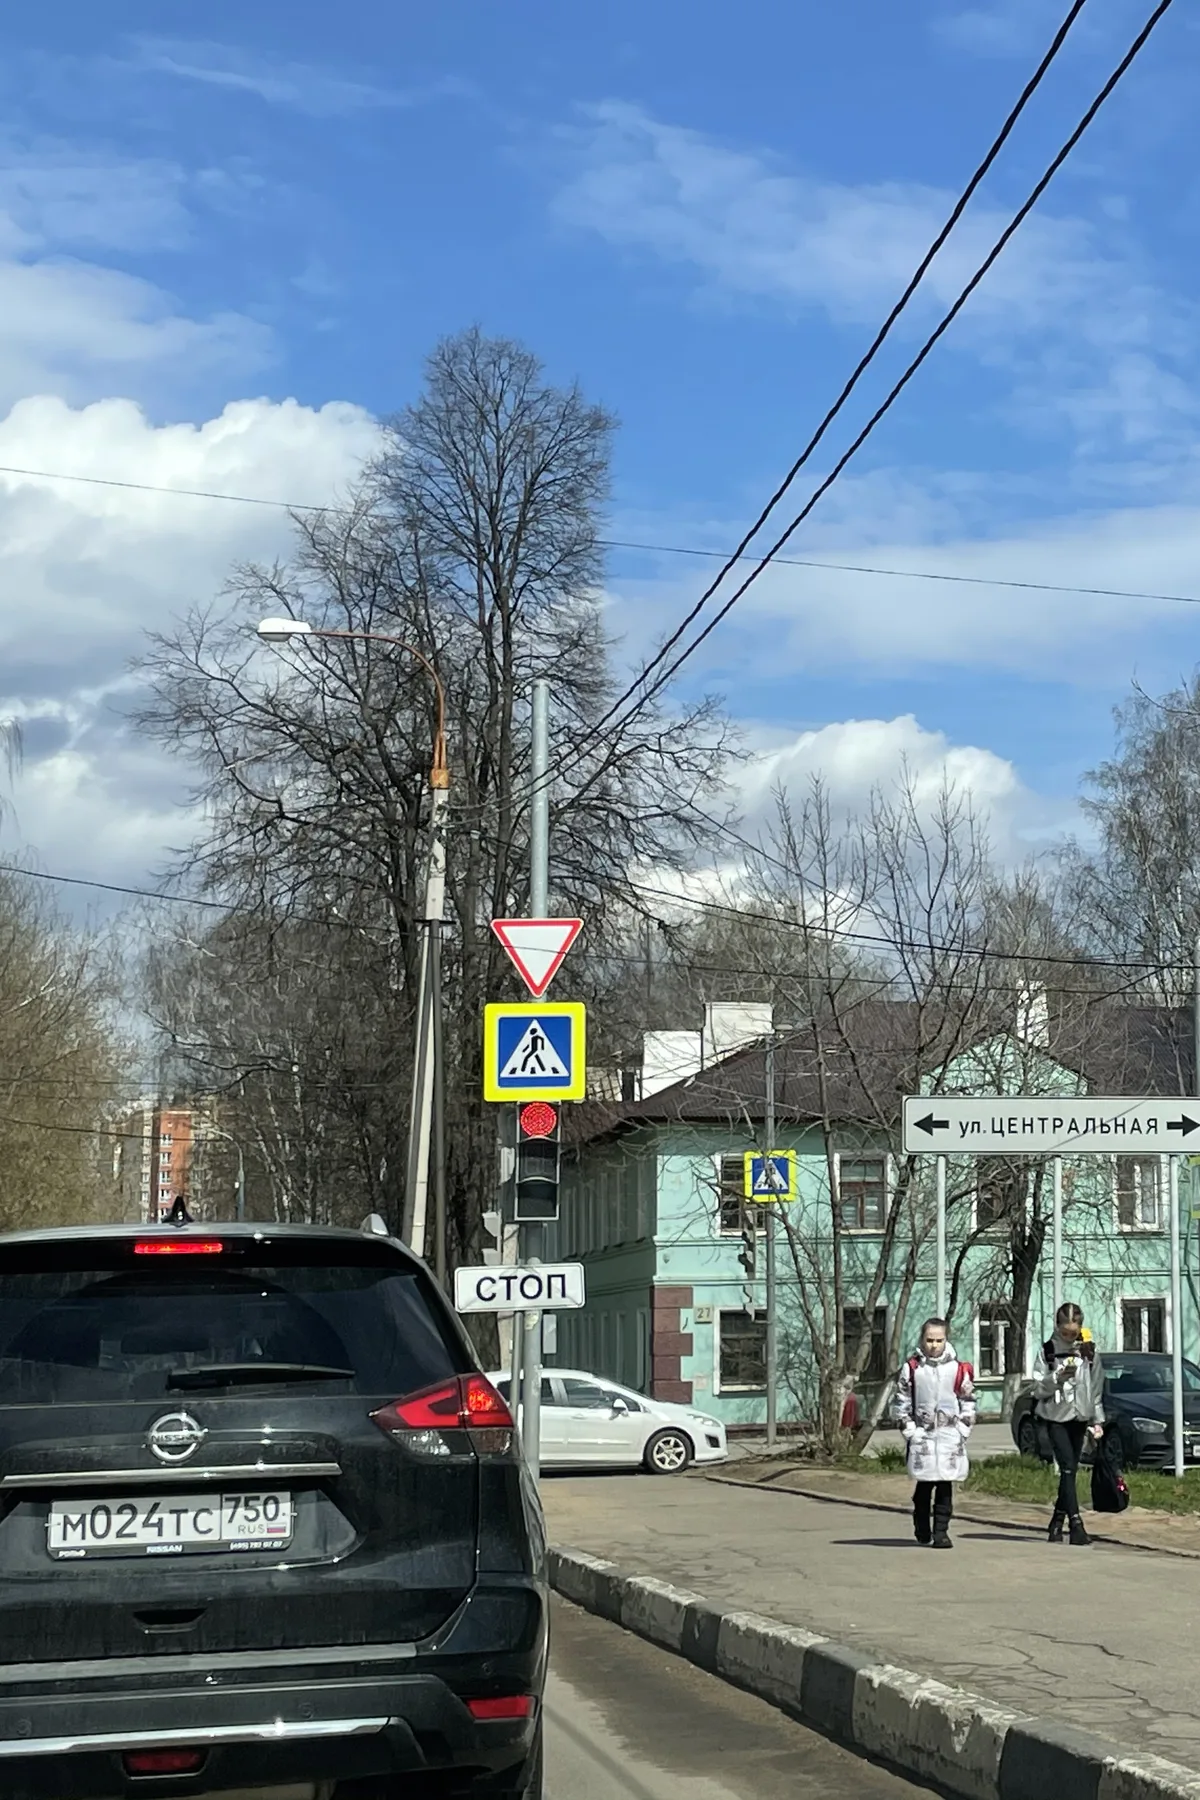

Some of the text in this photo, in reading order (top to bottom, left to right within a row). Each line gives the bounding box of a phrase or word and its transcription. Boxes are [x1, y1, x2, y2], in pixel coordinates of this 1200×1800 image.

[991, 1116, 1158, 1138] ЦЕНТРАЛЬНАЯ
[476, 1273, 567, 1302] СТОП
[697, 1307, 710, 1319] 27
[223, 1494, 280, 1524] 750
[237, 1523, 265, 1534] RUS
[146, 1544, 183, 1553] NISSAN
